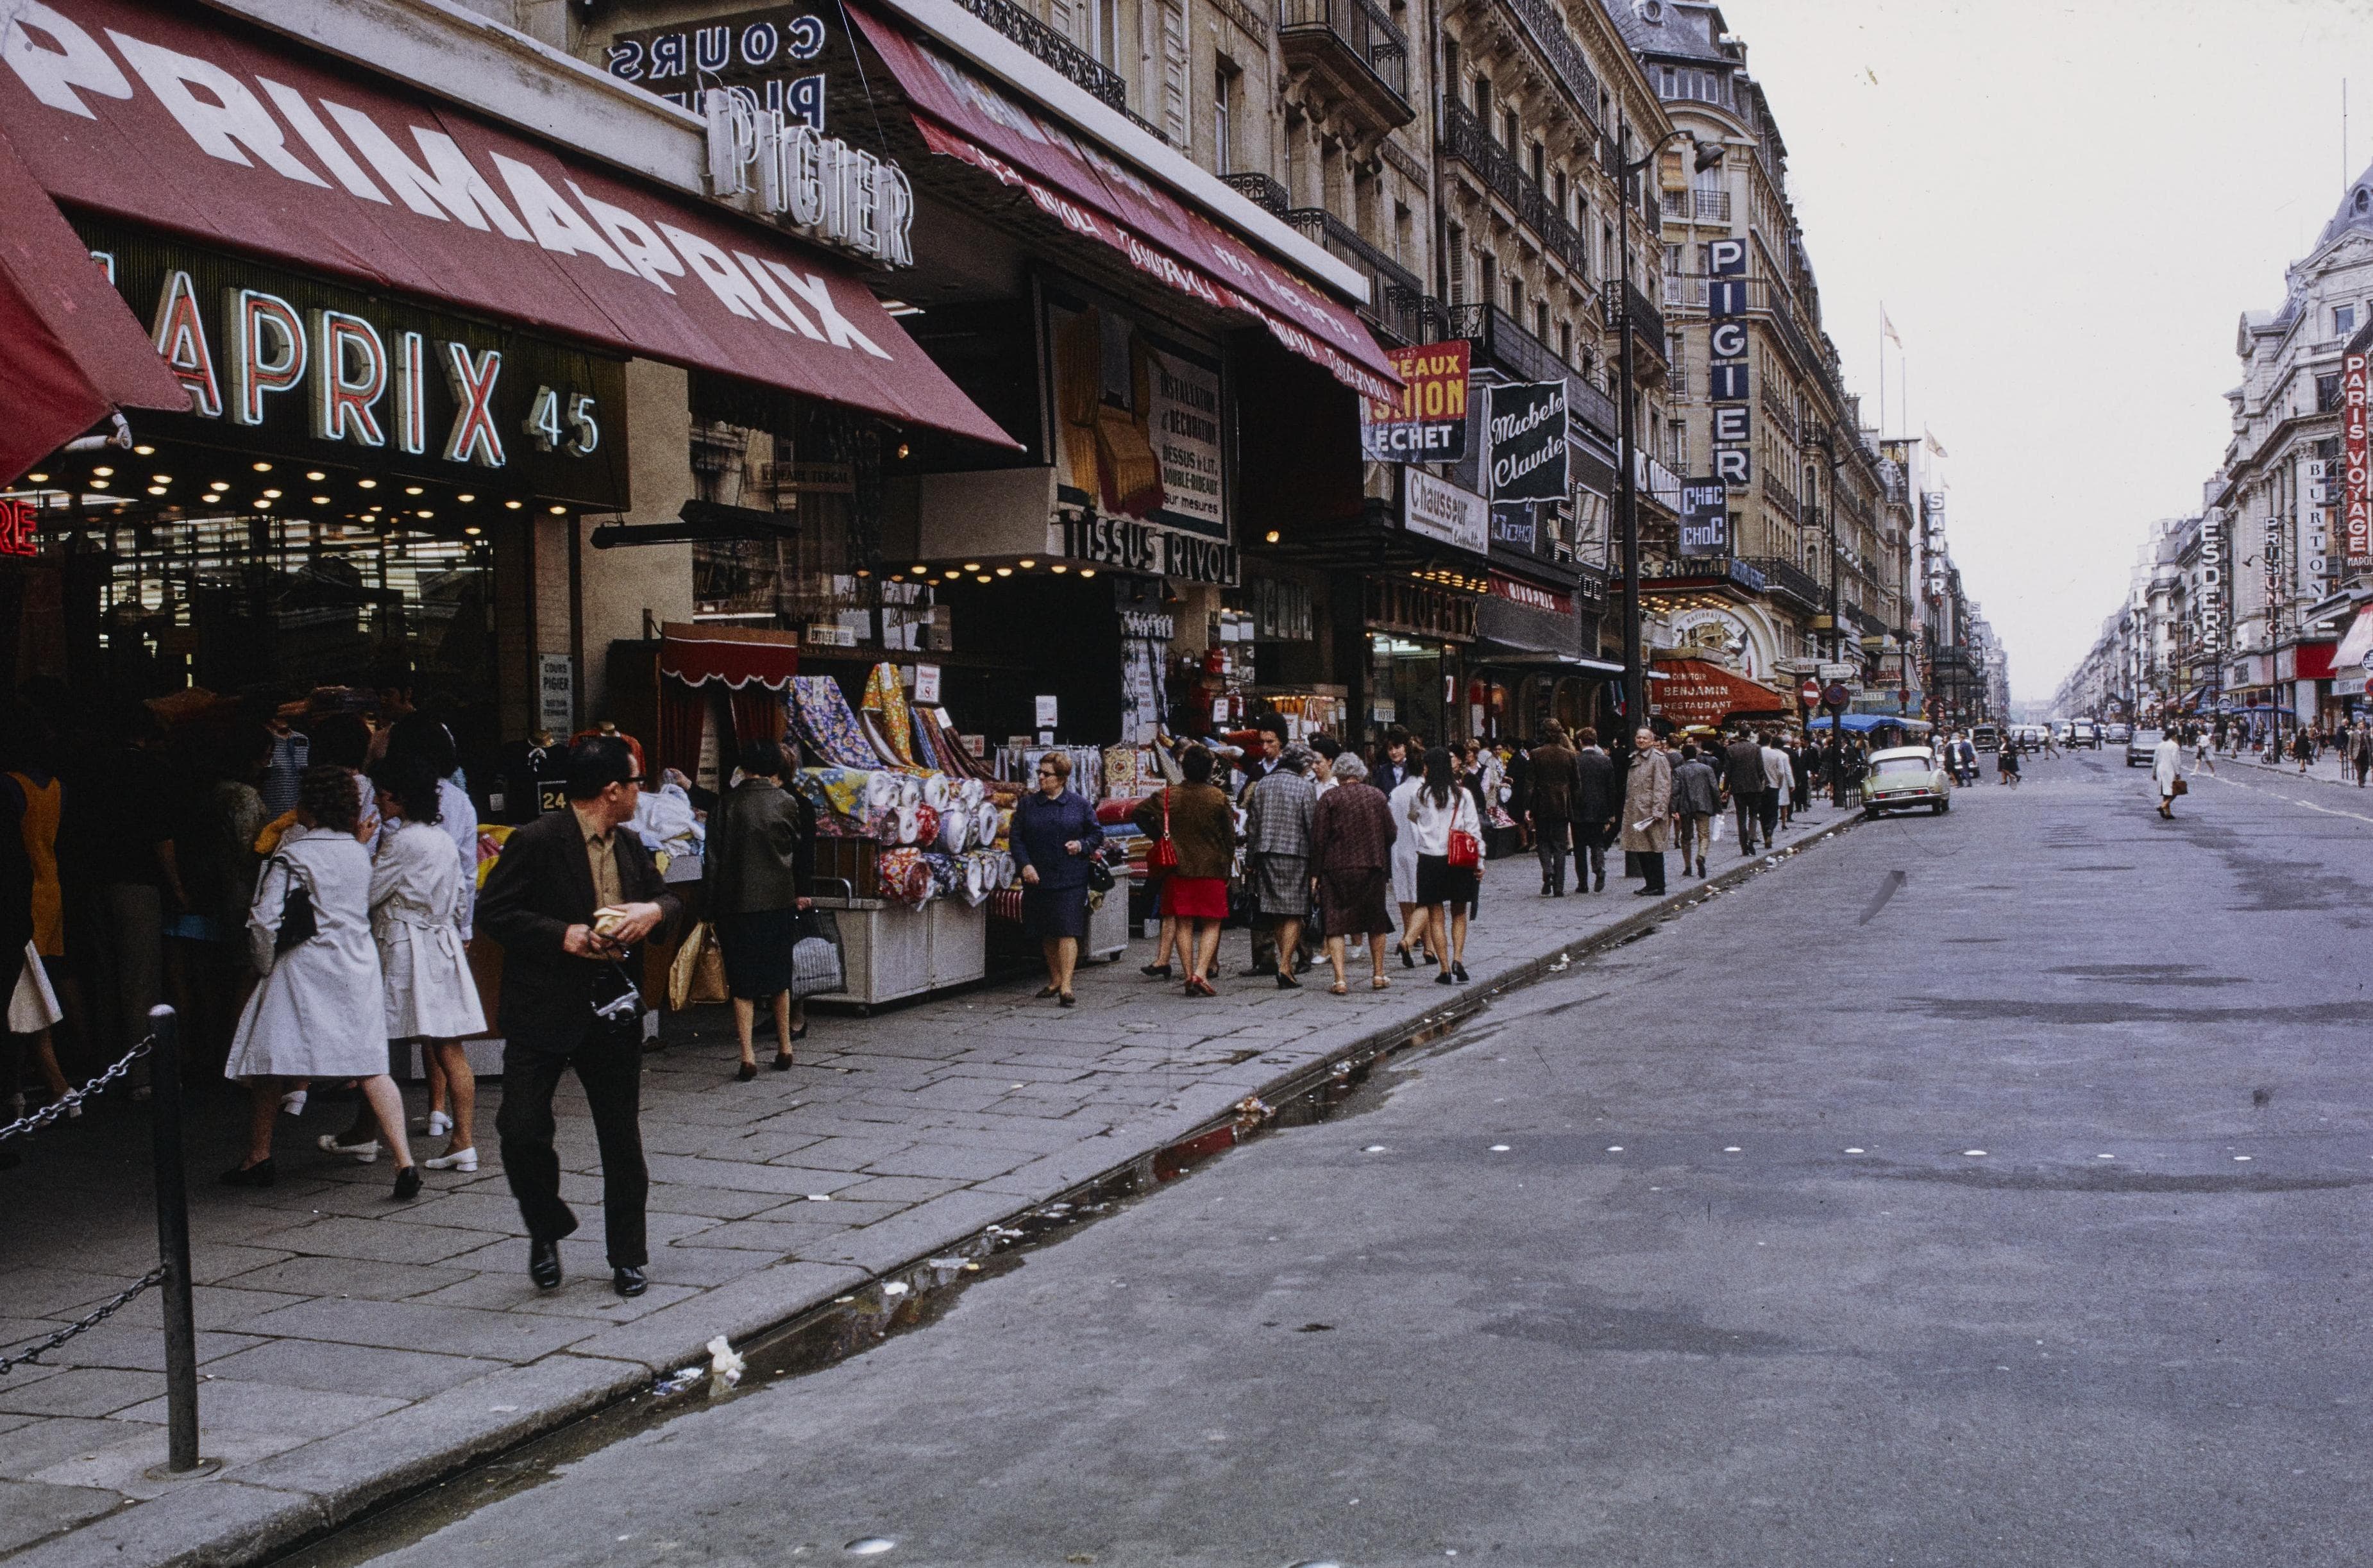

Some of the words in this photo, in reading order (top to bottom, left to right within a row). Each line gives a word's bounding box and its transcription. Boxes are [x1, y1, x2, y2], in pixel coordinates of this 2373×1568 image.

[0, 0, 893, 360] PRIMAPRIX
[712, 85, 914, 266] PIGIER
[1712, 241, 1747, 482] PIGIER
[539, 389, 600, 454] 45
[2347, 357, 2365, 441] PARIS
[1163, 444, 1196, 469] DESSUS
[1163, 466, 1218, 496] DOUBLE-RIDEAUX
[1494, 435, 1564, 488] Claude
[1164, 492, 1179, 505] sur
[1181, 497, 1219, 514] mesures
[1411, 472, 1468, 527] Chausseur
[1682, 485, 1723, 515] CHIC
[2347, 450, 2368, 553] VOYAGE
[1051, 510, 1157, 571] TISSUS
[1683, 516, 1724, 546] CHOC
[1929, 493, 1945, 596] SAMAR
[2310, 464, 2324, 596] BURTON
[2201, 521, 2221, 653] ESDERS
[2265, 517, 2284, 635] PRISUNIC
[543, 677, 569, 691] PIGIER
[545, 663, 568, 673] COURS
[1664, 686, 1729, 696] BENJAMIN
[1664, 701, 1732, 710] RESTAURANT
[543, 792, 567, 810] 24
